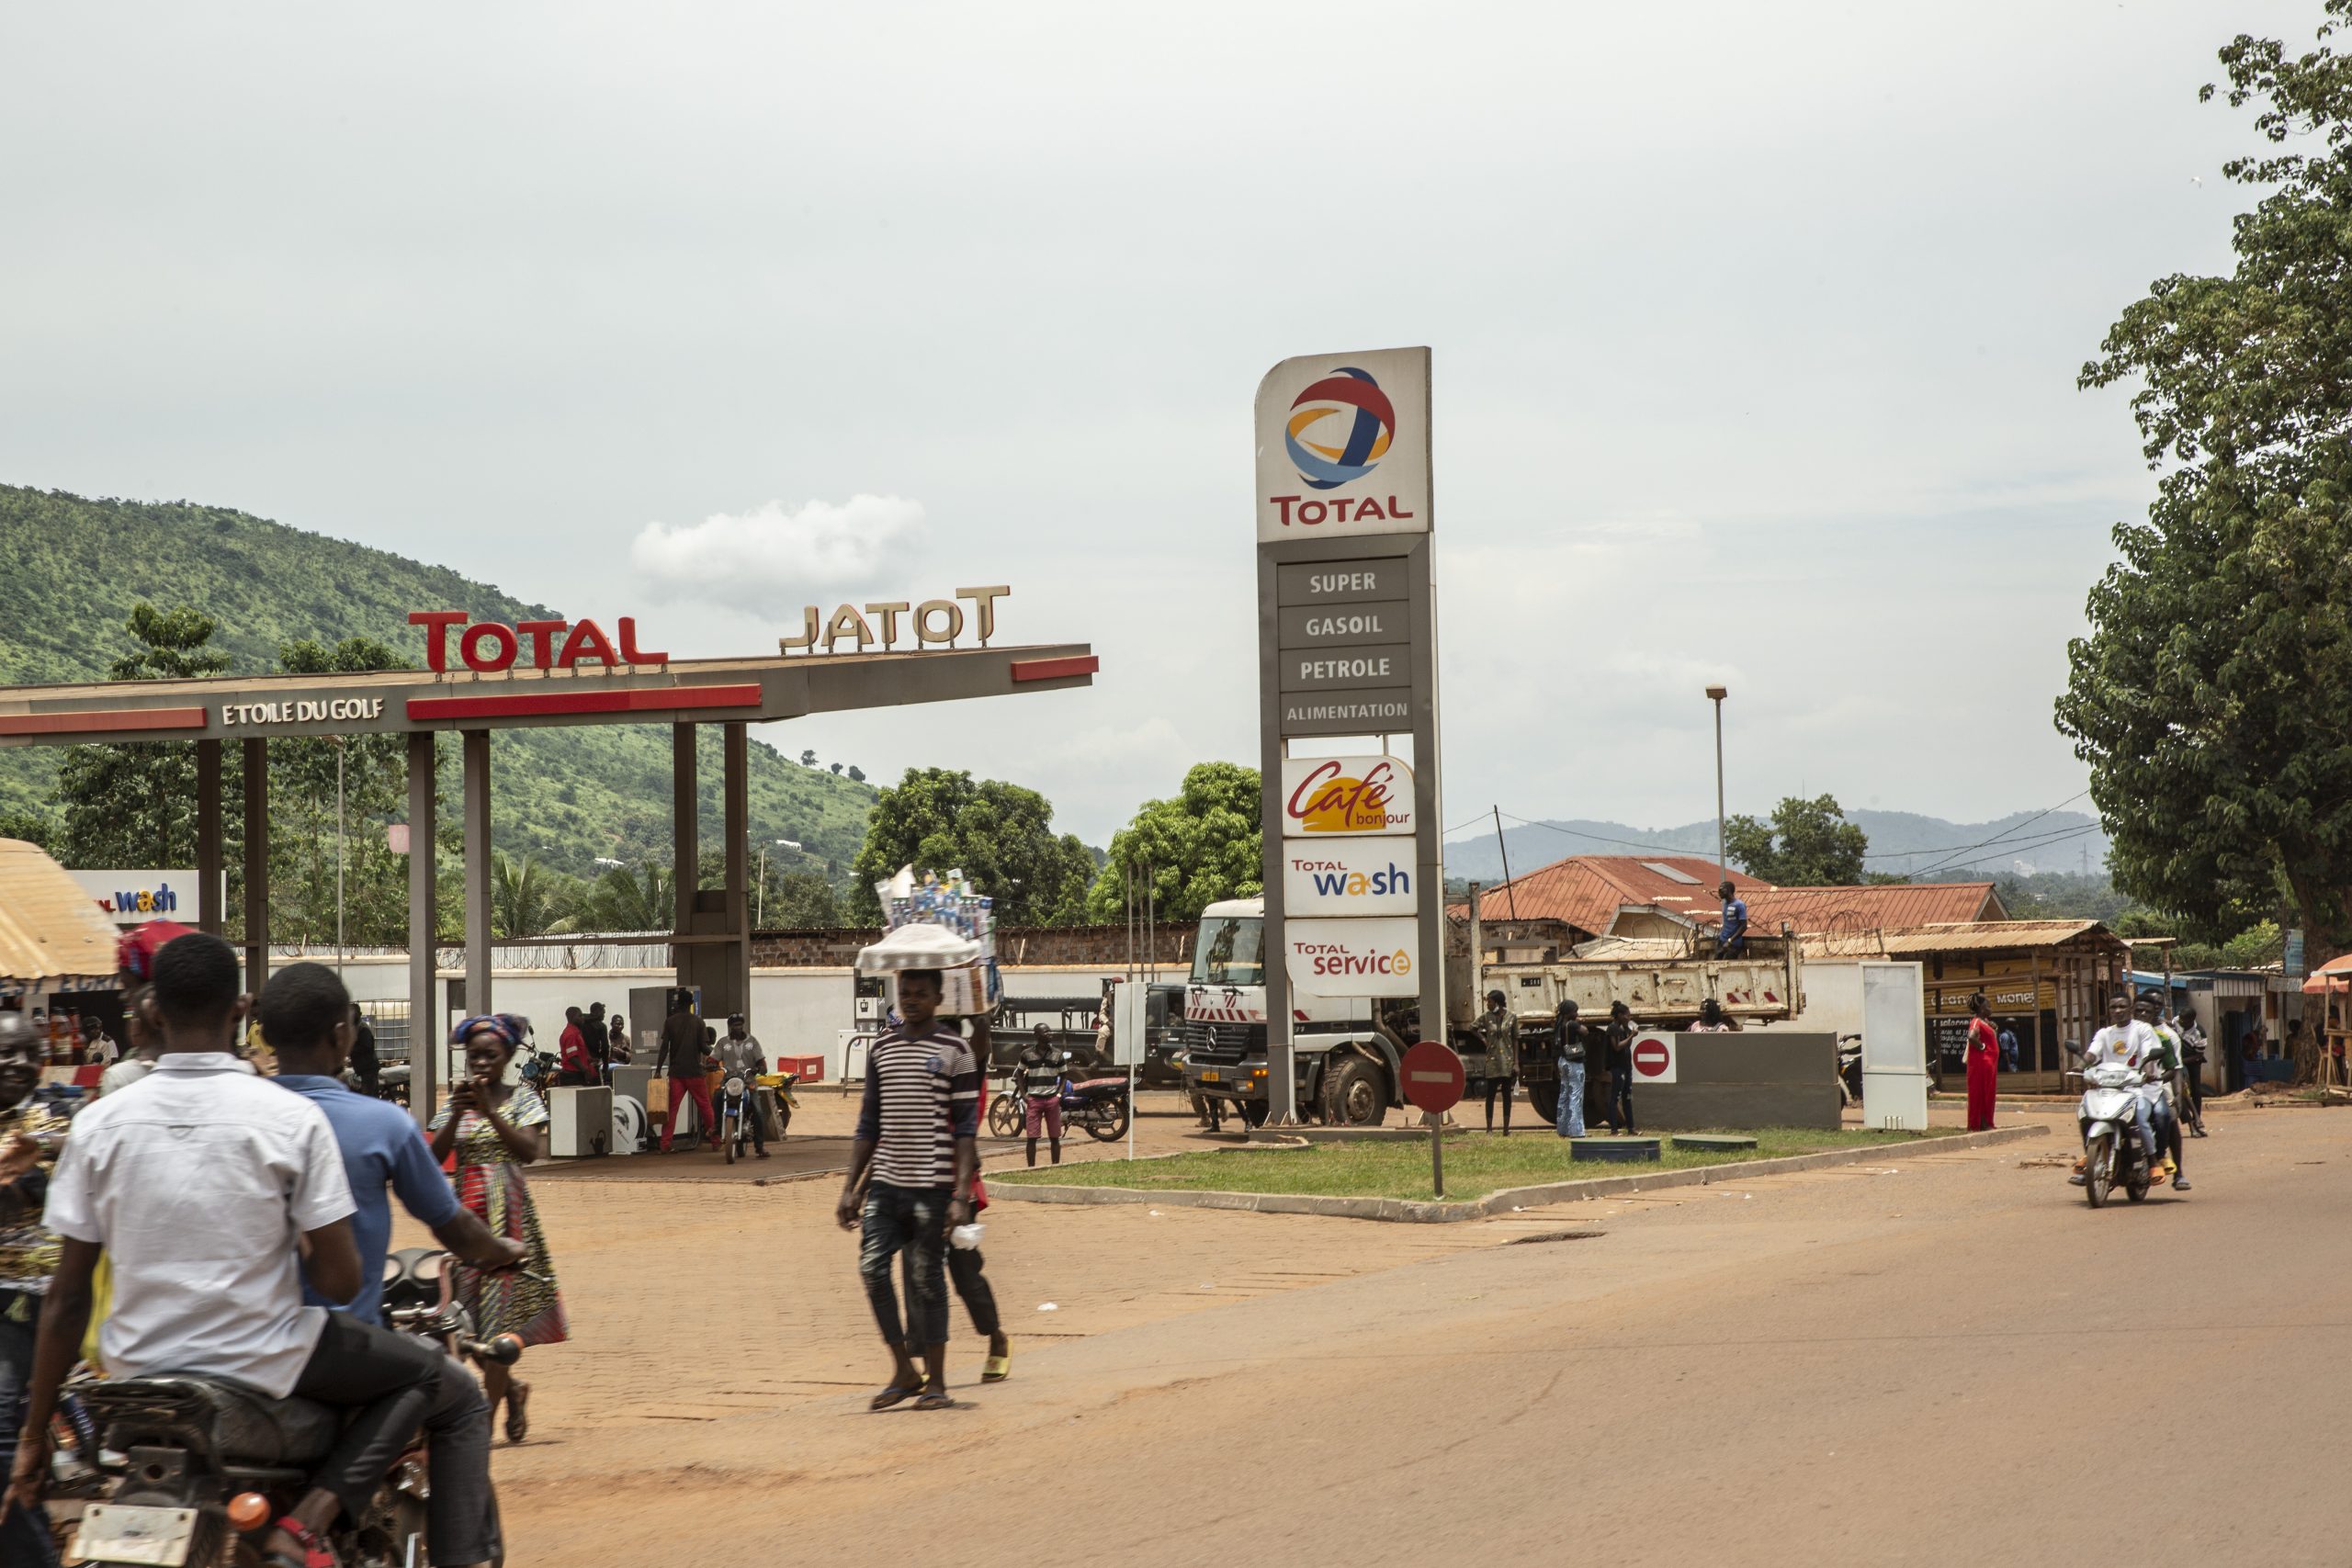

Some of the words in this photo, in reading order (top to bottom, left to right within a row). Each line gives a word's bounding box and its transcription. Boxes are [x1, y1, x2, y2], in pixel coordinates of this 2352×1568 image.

[1271, 495, 1414, 526] TOTAL
[1310, 572, 1376, 593] SUPER
[1306, 615, 1383, 637] GASOIL
[408, 611, 669, 672] TOTAL
[1300, 658, 1390, 680] PETROLE
[222, 703, 294, 726] ETOILE
[297, 700, 327, 722] DU
[331, 698, 384, 720] GOLF
[1286, 702, 1408, 722] ALIMENTATION
[1287, 761, 1395, 828] Café
[1356, 810, 1411, 827] bonjour
[1292, 860, 1348, 872] TOTAL
[1313, 862, 1409, 896] wash
[115, 883, 176, 912] wash
[1294, 942, 1351, 954] TOTAL
[1313, 949, 1411, 976] service
